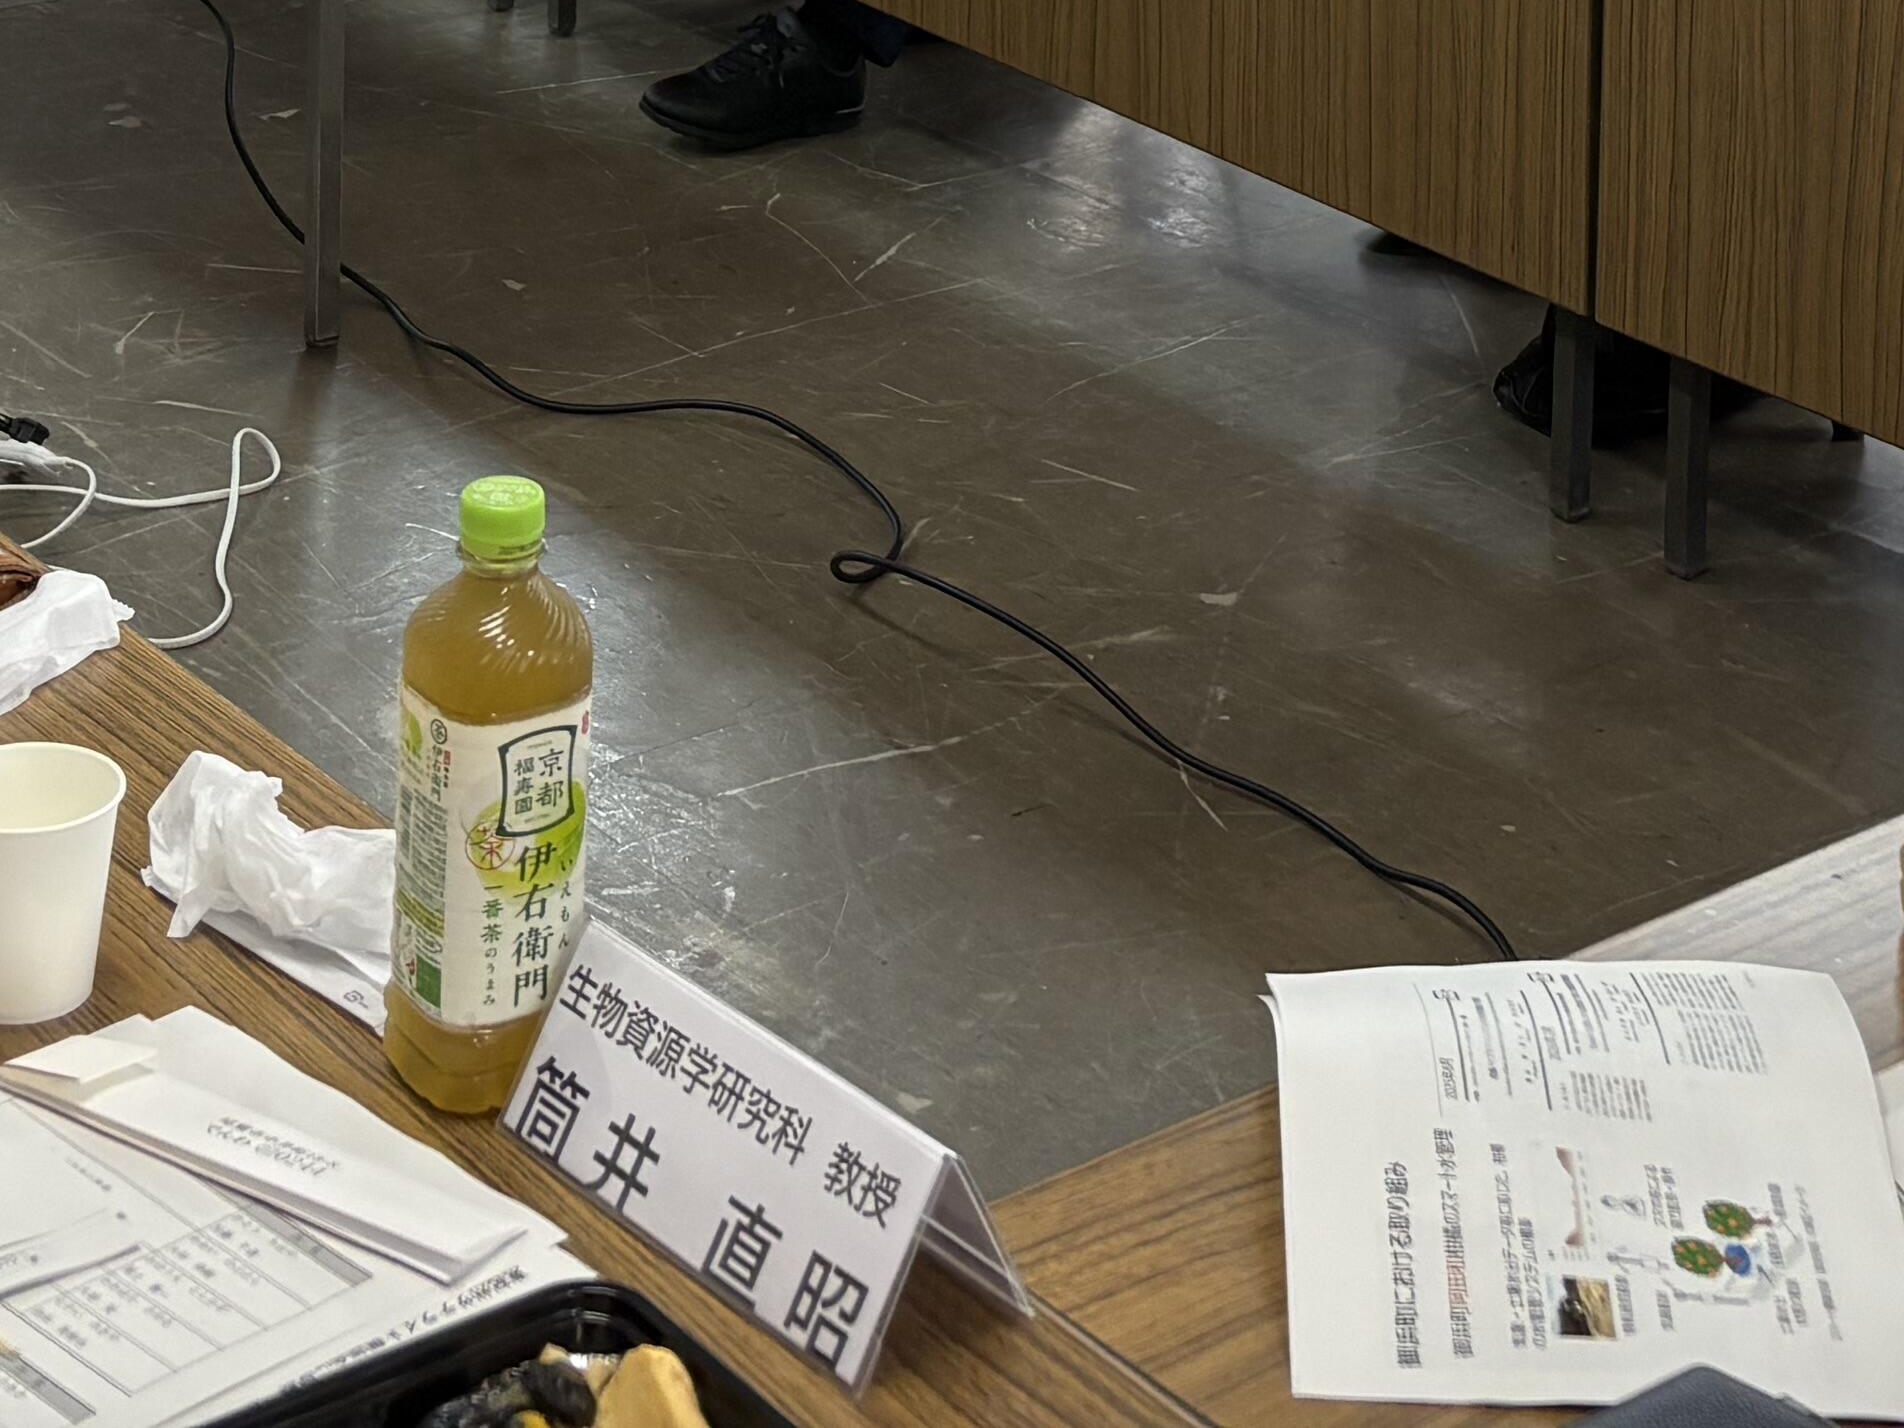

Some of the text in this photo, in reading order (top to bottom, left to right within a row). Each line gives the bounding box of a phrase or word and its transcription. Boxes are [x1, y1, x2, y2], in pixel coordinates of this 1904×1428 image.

[535, 748, 565, 809] 京都
[479, 884, 505, 1007] 一番茶のうまみ
[511, 841, 557, 1008] 伊右衛門
[558, 856, 574, 949] いえもん
[557, 963, 904, 1229] 生物資源学研究科 教授
[514, 1054, 872, 1365] 筒井 直昭
[1382, 1159, 1424, 1370] 御浜町における取り組み
